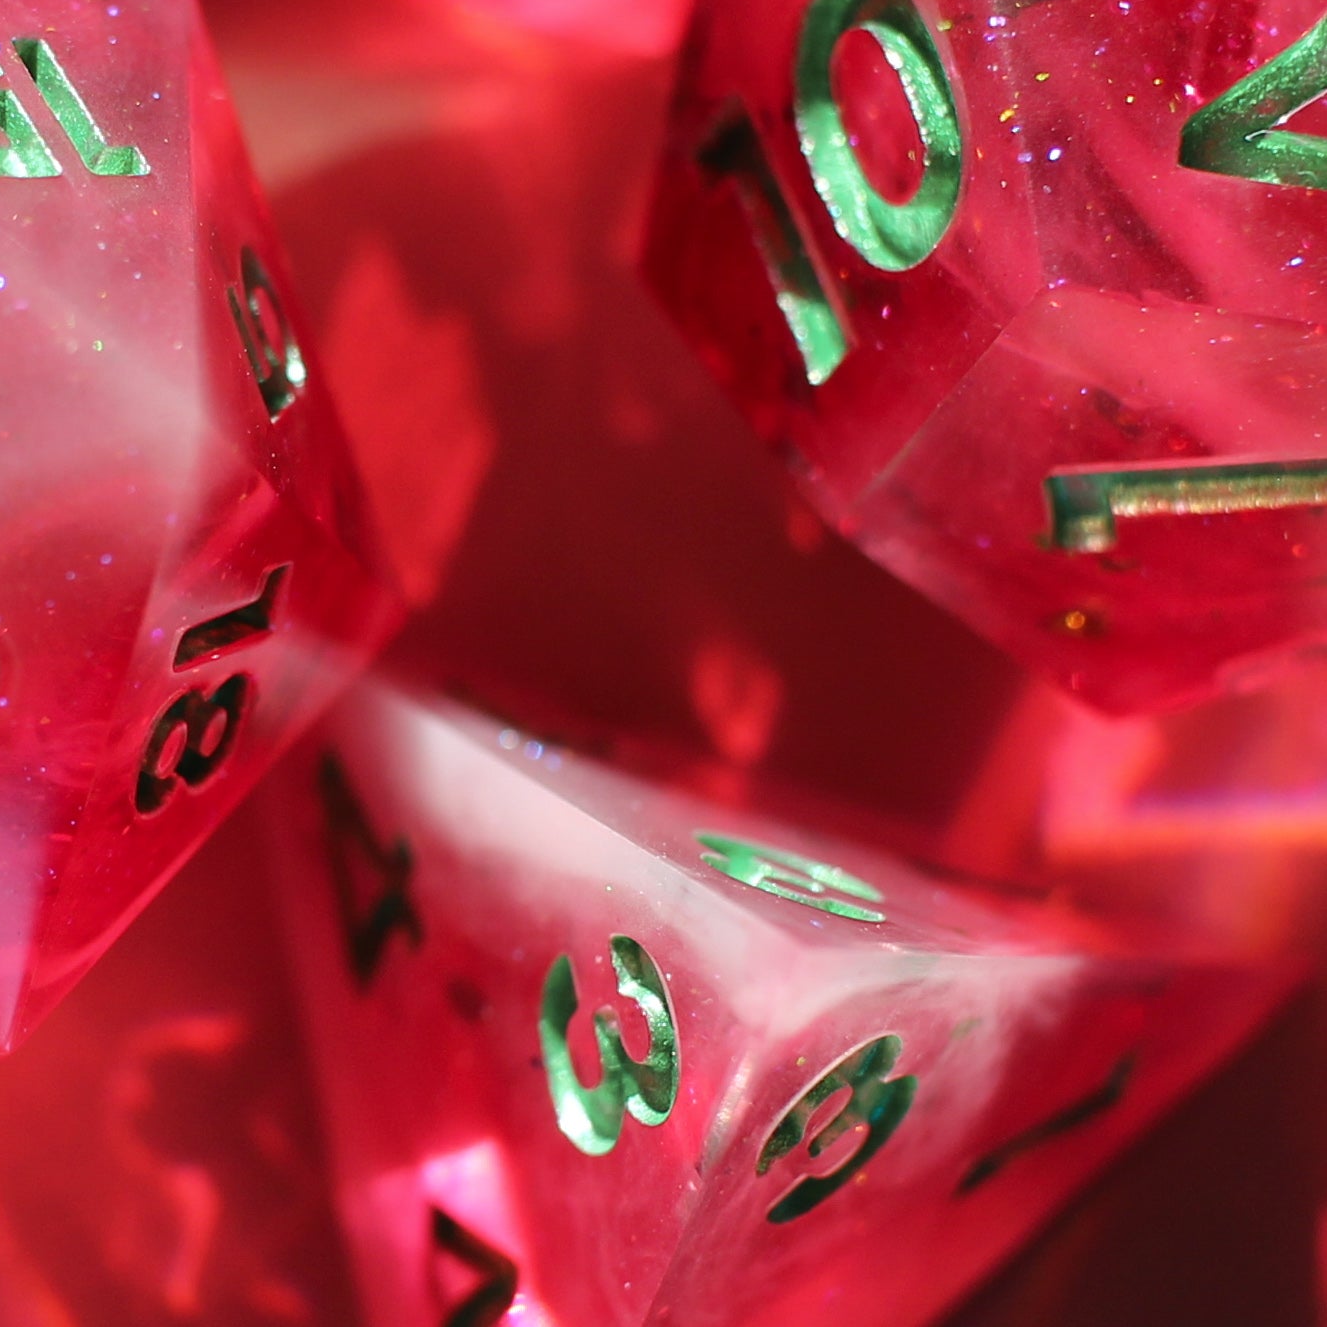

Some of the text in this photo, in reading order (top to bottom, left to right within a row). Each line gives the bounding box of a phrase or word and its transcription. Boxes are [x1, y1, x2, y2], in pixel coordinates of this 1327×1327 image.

[133, 562, 290, 818] 18
[538, 933, 680, 1156] 3
[754, 1034, 918, 1225] 3
